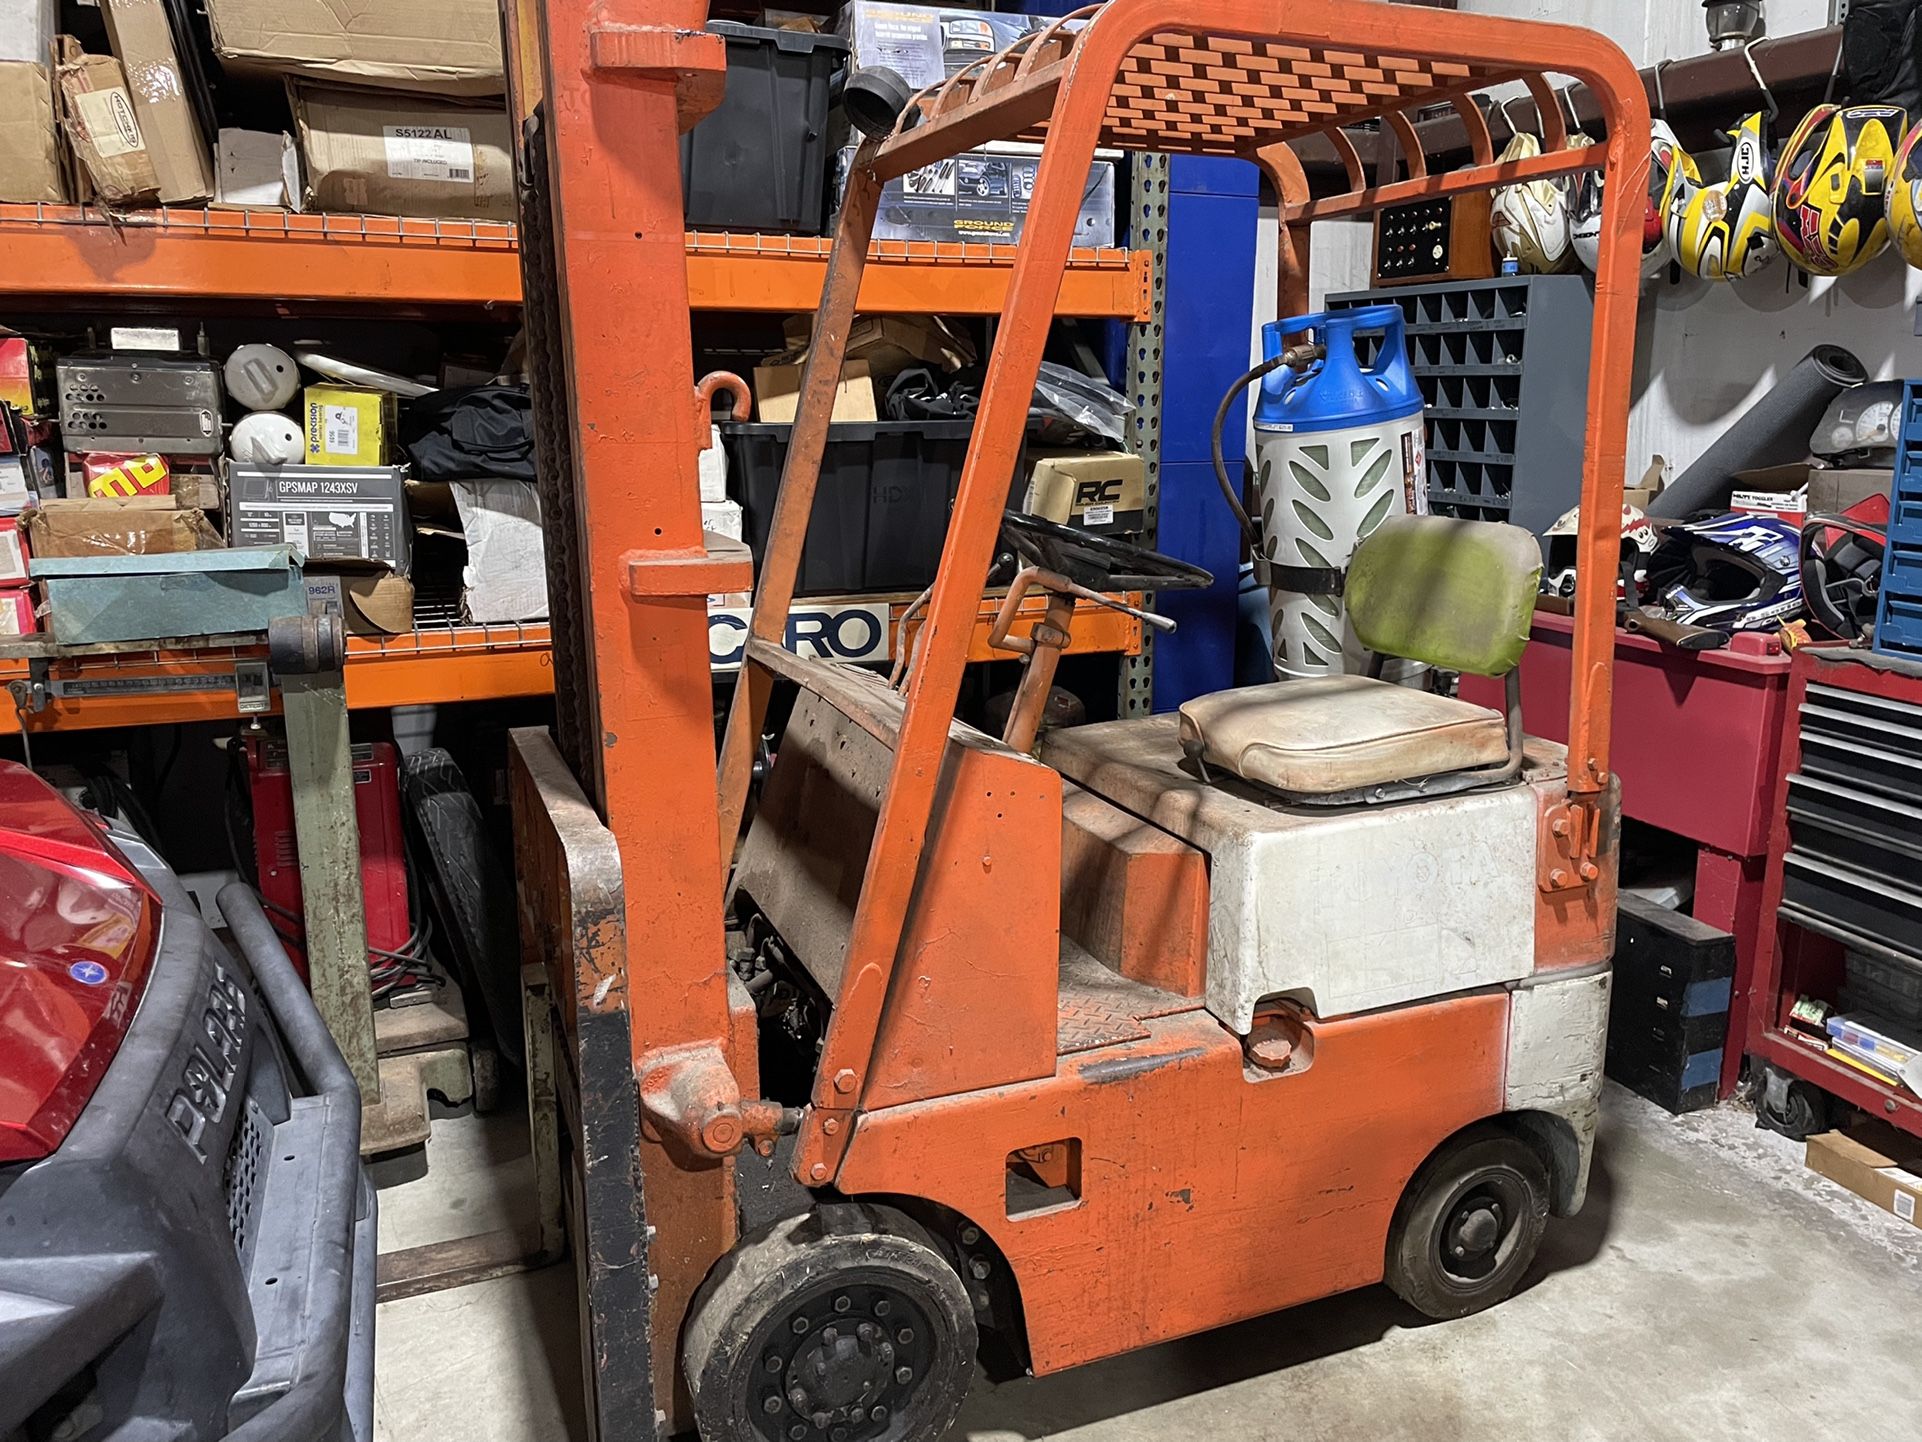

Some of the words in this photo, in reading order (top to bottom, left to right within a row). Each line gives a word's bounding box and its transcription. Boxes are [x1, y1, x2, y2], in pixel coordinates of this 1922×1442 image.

[395, 128, 453, 140] S5122AL
[1740, 144, 1750, 176] HJC
[953, 219, 1015, 227] GROUND
[309, 402, 319, 443] precision
[279, 481, 318, 494] GPSMAP
[320, 481, 358, 494] 1243XSV
[1075, 479, 1124, 503] RC
